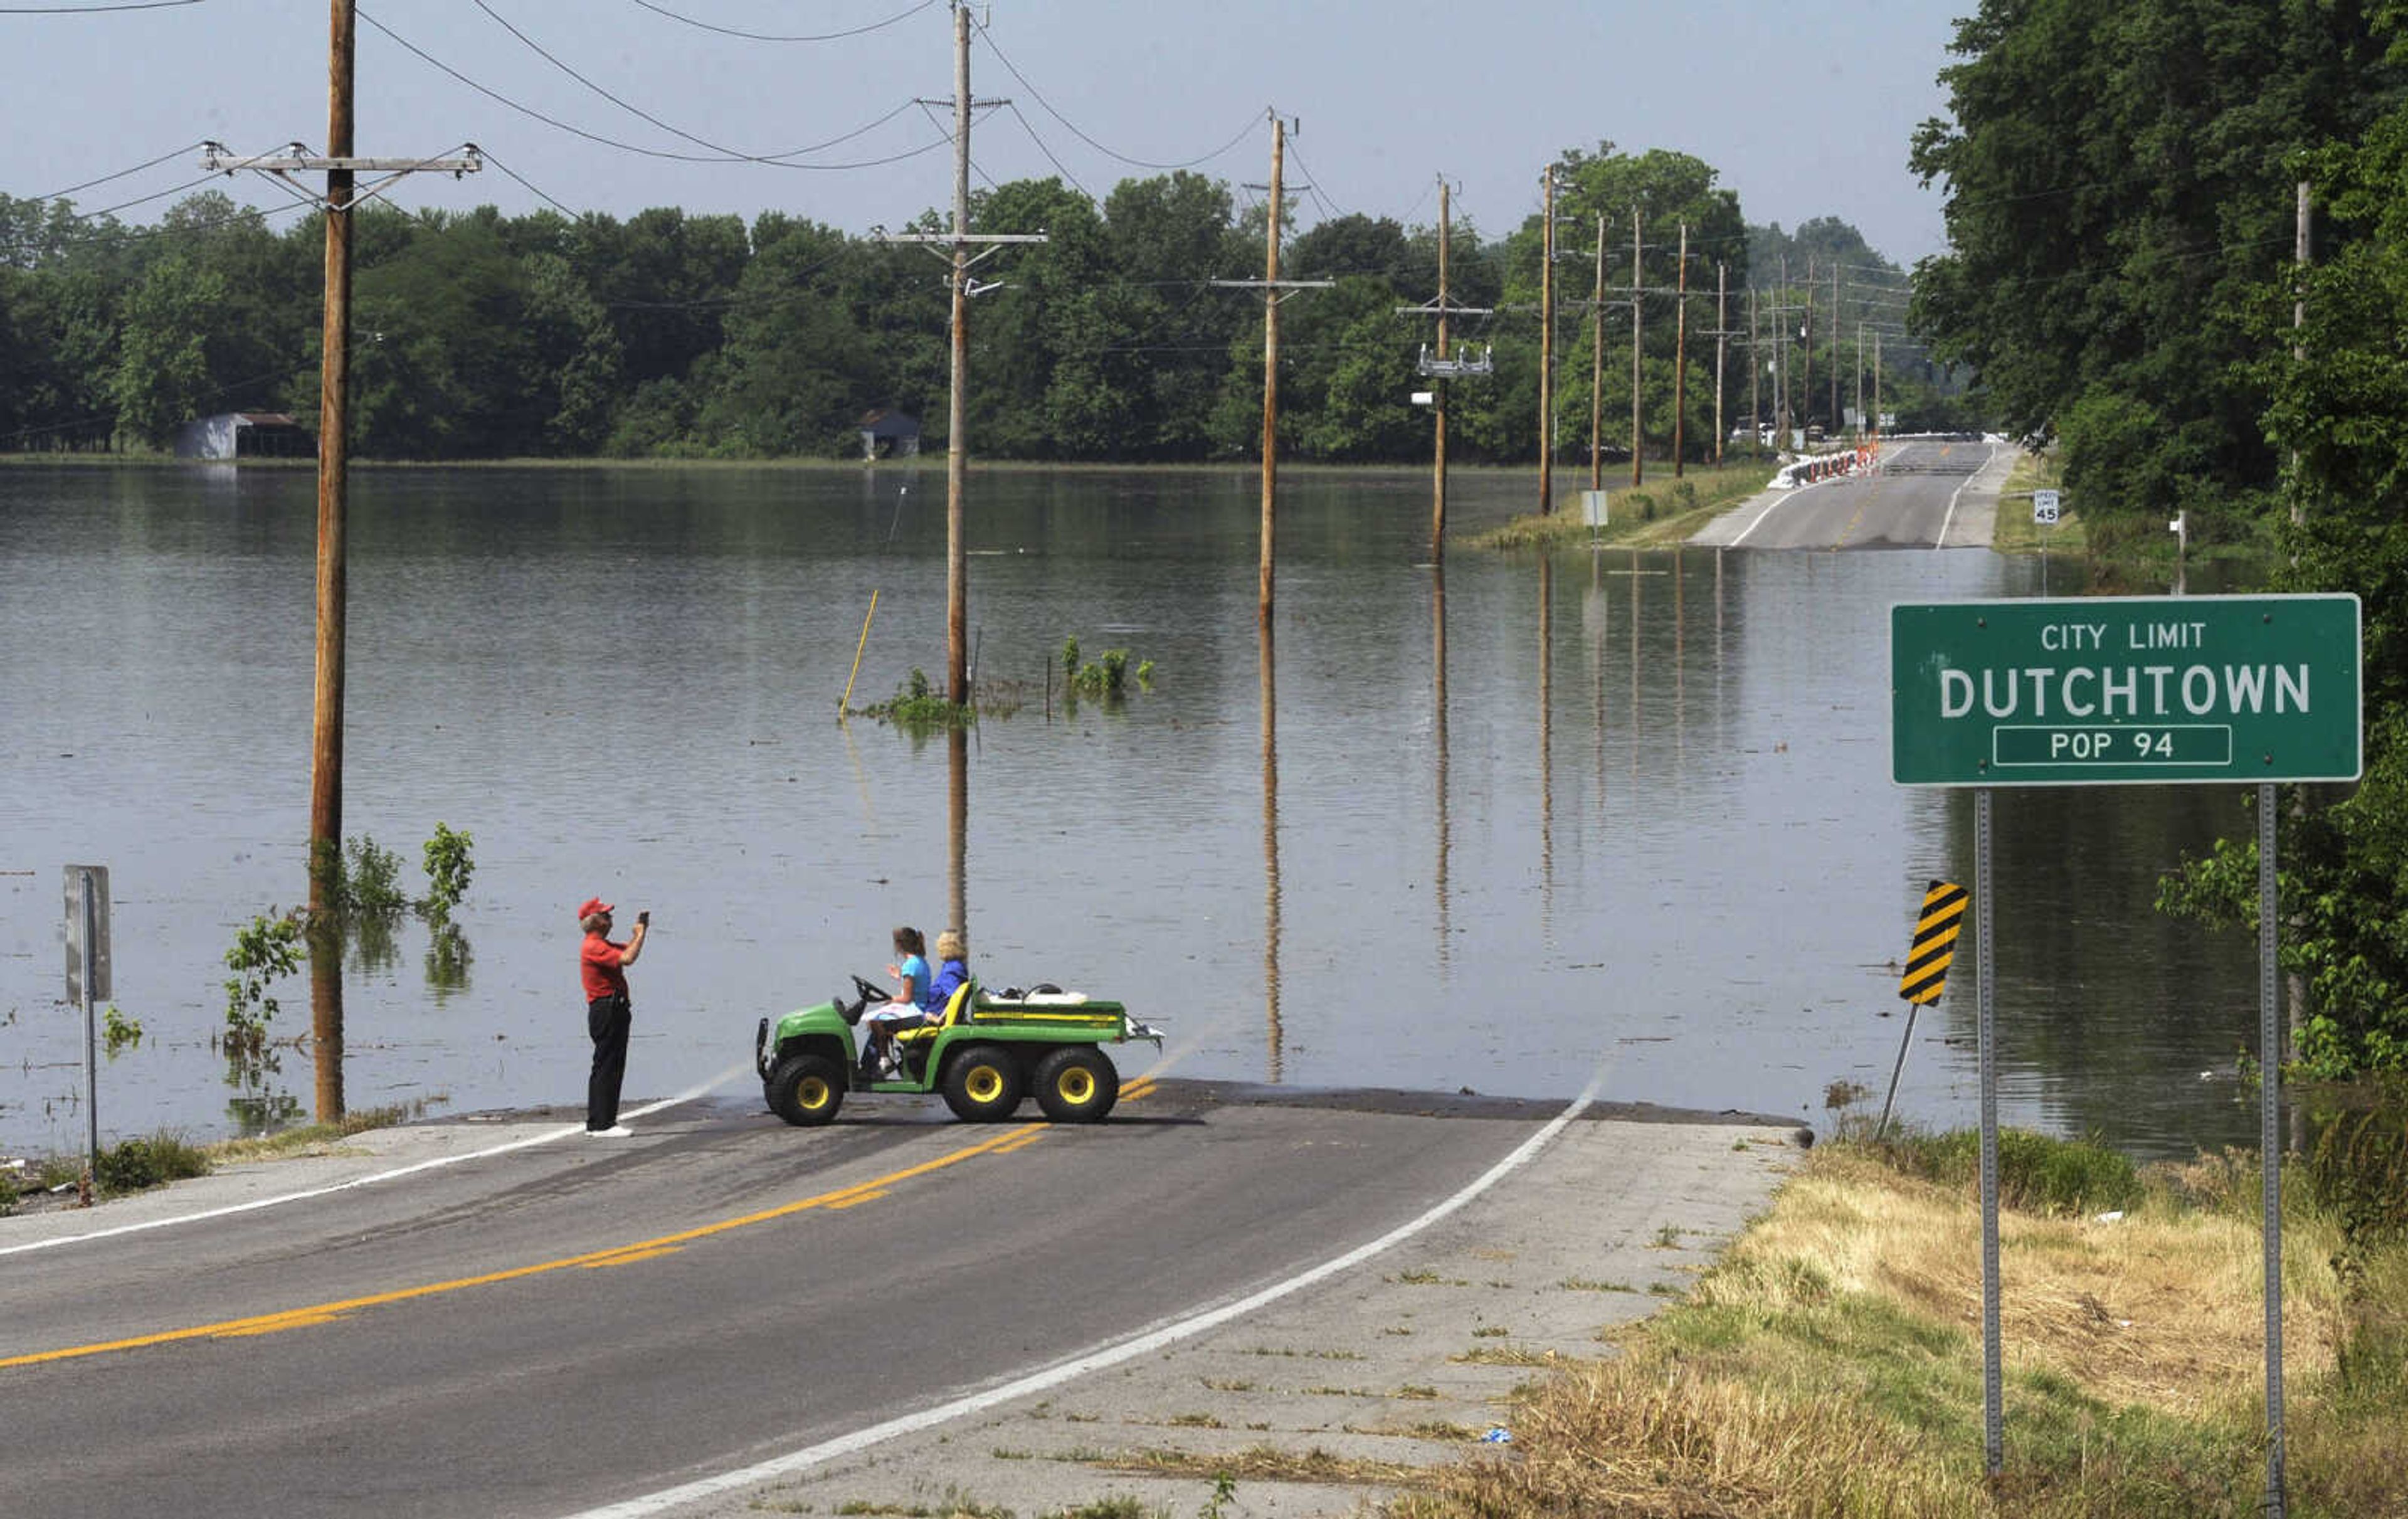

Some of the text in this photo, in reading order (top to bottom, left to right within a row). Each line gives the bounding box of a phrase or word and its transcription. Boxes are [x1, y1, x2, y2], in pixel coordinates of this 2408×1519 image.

[2037, 509, 2056, 520] 45
[2042, 623, 2206, 650] CITY LIMIT
[1941, 664, 2310, 718] DUTCHTOWN
[2051, 732, 2173, 759] POP 94
